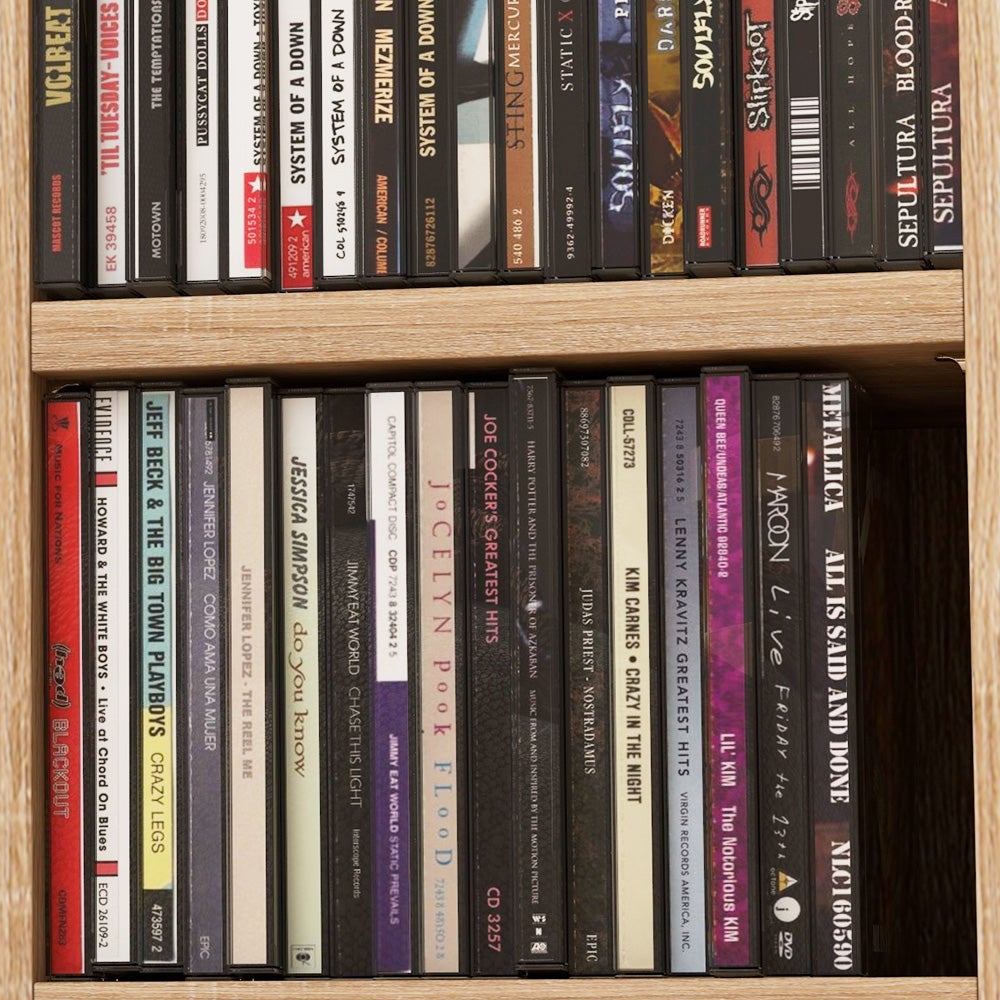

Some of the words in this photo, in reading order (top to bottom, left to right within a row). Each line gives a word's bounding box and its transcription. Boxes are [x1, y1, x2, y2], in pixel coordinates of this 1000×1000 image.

[559, 10, 573, 21] X
[198, 26, 207, 70] DOLLS
[290, 22, 303, 71] DOWN
[561, 29, 573, 91] STATIC
[290, 78, 304, 87] A
[198, 75, 207, 144] PUSSYCAT
[290, 95, 305, 114] OF
[290, 121, 306, 184] SYSTEM
[933, 83, 954, 223] SEPULTURA
[897, 114, 918, 247] SEPULTURA
[105, 207, 118, 251] 39458
[152, 202, 161, 258] MOTOWN
[106, 255, 116, 271] EK
[300, 230, 310, 278] american
[623, 409, 634, 468] COLL-57273
[204, 481, 215, 537] JENNIFER
[204, 542, 215, 580] LOPEZ
[675, 519, 686, 570] LENNY
[241, 566, 251, 631] JENNIFER
[625, 568, 639, 592] KIM
[204, 593, 215, 639] COMO
[580, 588, 592, 625] JUDAS
[626, 598, 639, 649] CARNES
[676, 579, 687, 644] KRAVITZ
[204, 643, 215, 673] AMA
[241, 635, 252, 678] LOPEZ
[582, 630, 594, 672] PRIEST
[204, 678, 215, 706] UNA
[242, 690, 252, 716] THE
[626, 668, 640, 710] CRAZY
[676, 653, 689, 733] GREATEST
[204, 708, 215, 750] MUJER
[242, 721, 252, 755] REEL
[583, 686, 595, 774] NOSTRADAMUS
[627, 716, 641, 728] IN
[389, 734, 398, 766] JIMMY
[627, 735, 641, 759] THE
[678, 742, 689, 776] HITS
[721, 734, 735, 755] LIL'
[243, 760, 252, 778] ME
[390, 771, 398, 790] EAT
[627, 764, 641, 803] NIGHT
[721, 762, 735, 786] KIM
[390, 793, 399, 832] WORLD
[680, 792, 688, 826] VIRGIN
[722, 806, 736, 831] The
[390, 836, 398, 870] STATIC
[681, 830, 689, 876] RECORDS
[722, 837, 737, 911] Notorious
[390, 874, 399, 924] PREVAILS
[488, 888, 500, 908] CD
[681, 880, 689, 928] AMERICA,
[200, 936, 209, 959] EPIC
[488, 914, 500, 952] 3257
[587, 935, 597, 962] EPIC
[682, 932, 690, 952] INC.
[724, 917, 738, 942] KIM
